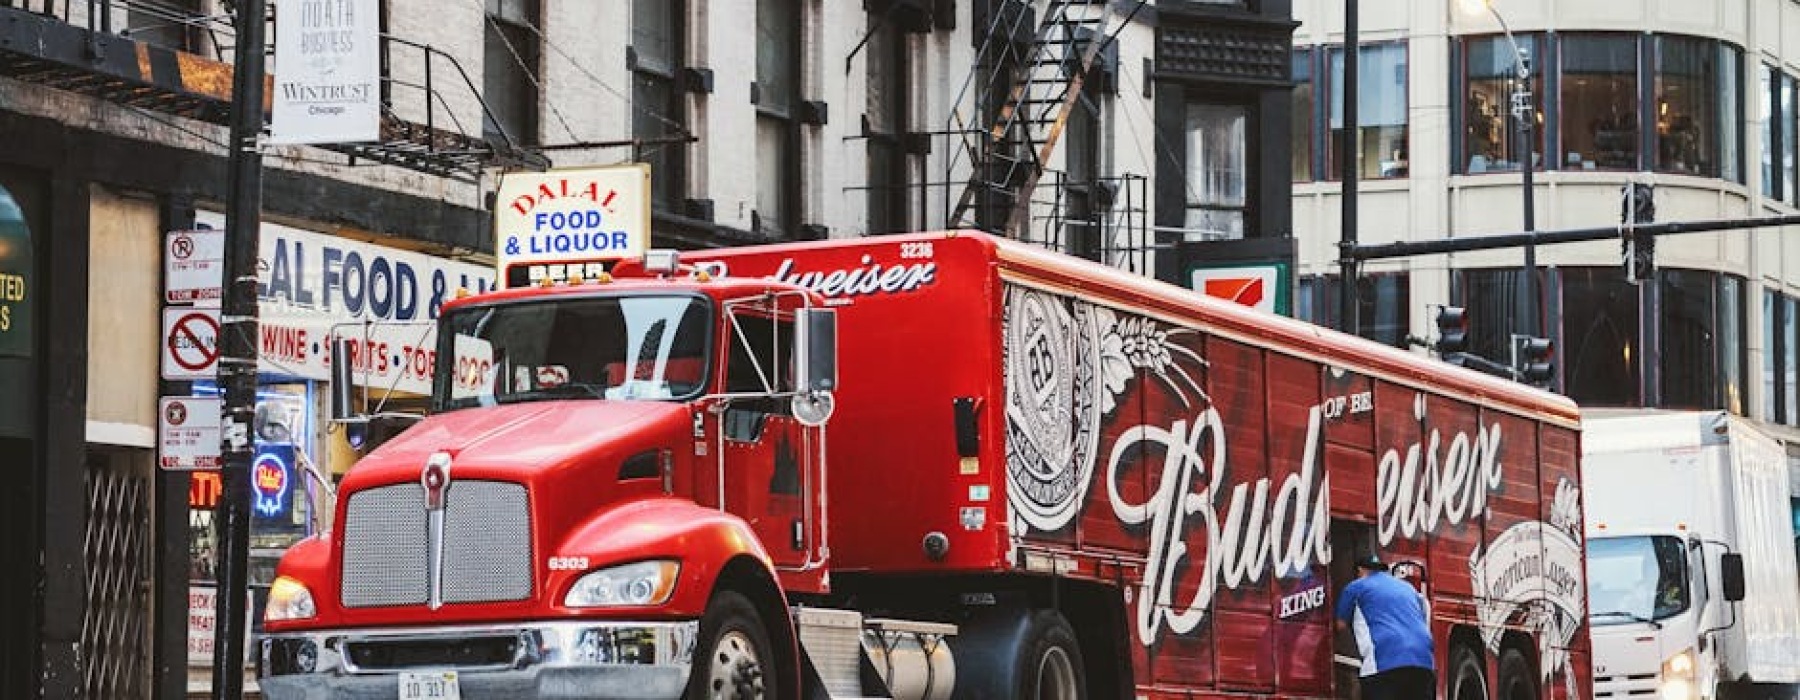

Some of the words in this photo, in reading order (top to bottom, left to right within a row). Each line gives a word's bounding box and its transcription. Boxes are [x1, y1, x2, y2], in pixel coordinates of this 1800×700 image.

[281, 82, 371, 101] WINTRUST
[308, 104, 345, 115] Chicago
[510, 179, 617, 215] DALAL
[535, 210, 601, 231] FOOD
[505, 236, 520, 255] &
[530, 231, 628, 253] LIQUOR
[322, 247, 418, 321] FOOD
[262, 325, 308, 363] WINE
[1279, 586, 1326, 619] KING
